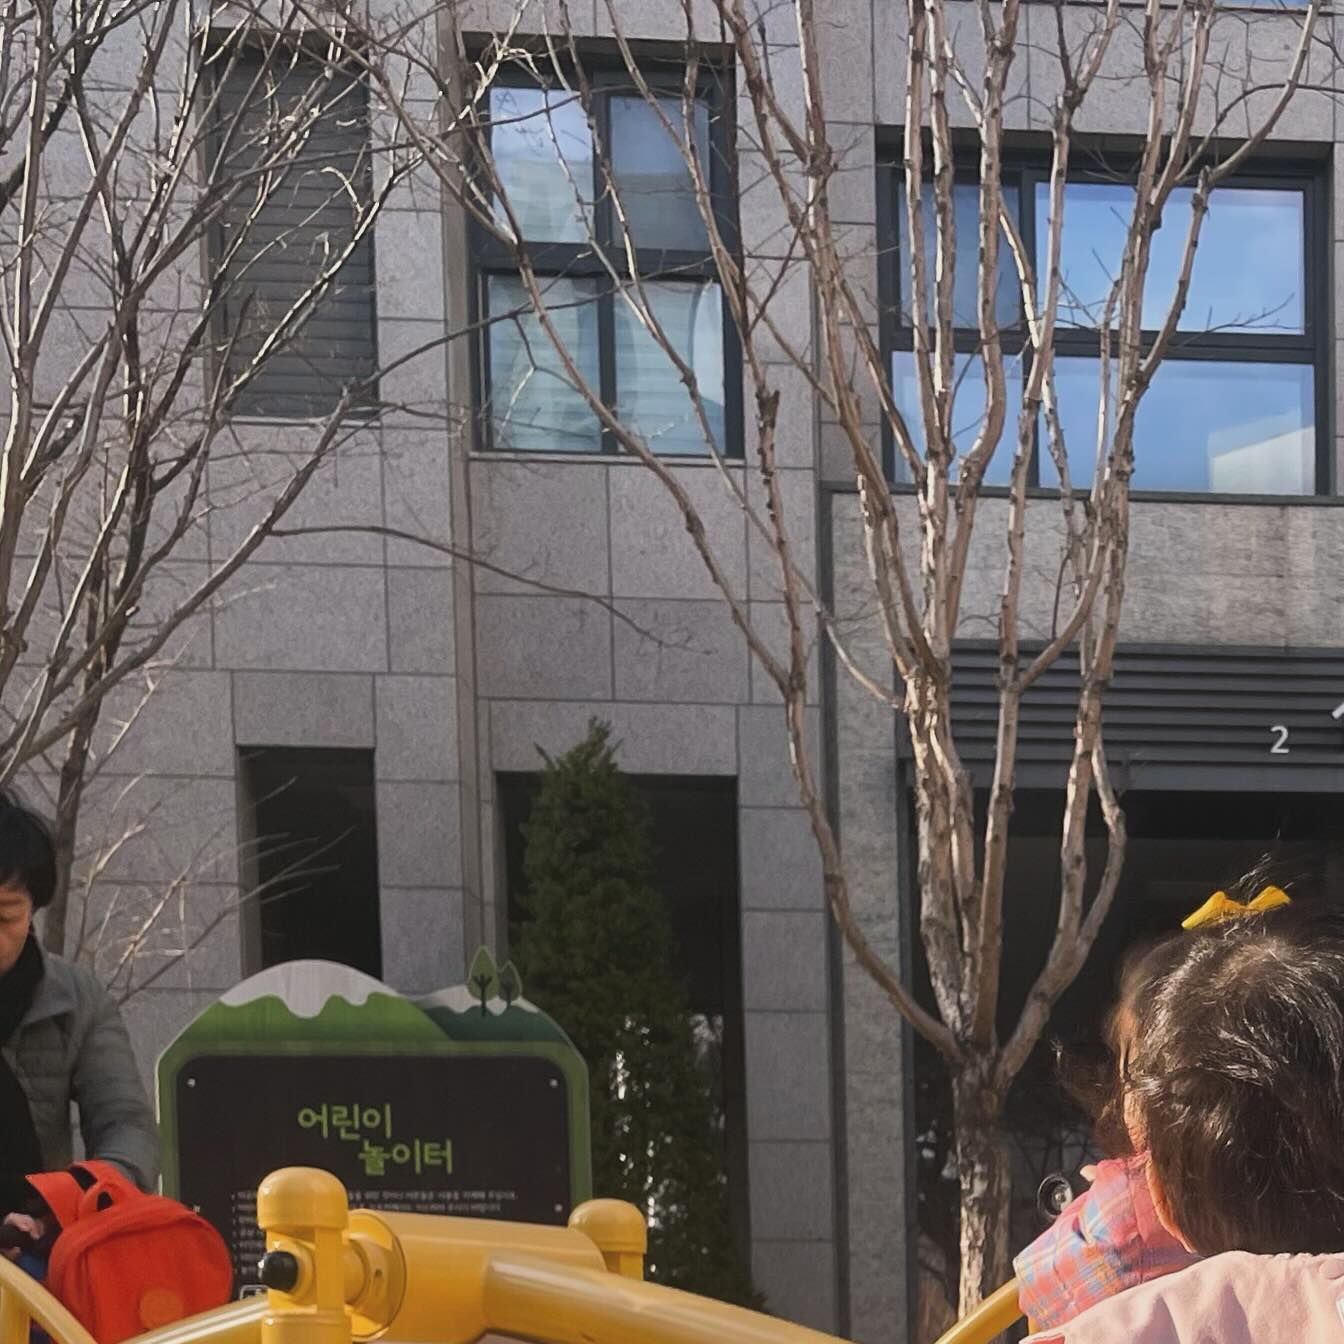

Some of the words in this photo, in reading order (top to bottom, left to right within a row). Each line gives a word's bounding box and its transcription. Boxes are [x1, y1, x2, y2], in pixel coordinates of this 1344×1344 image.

[1269, 725, 1290, 754] 2
[298, 1103, 391, 1140] 어린이
[358, 1138, 452, 1176] 놀이터
